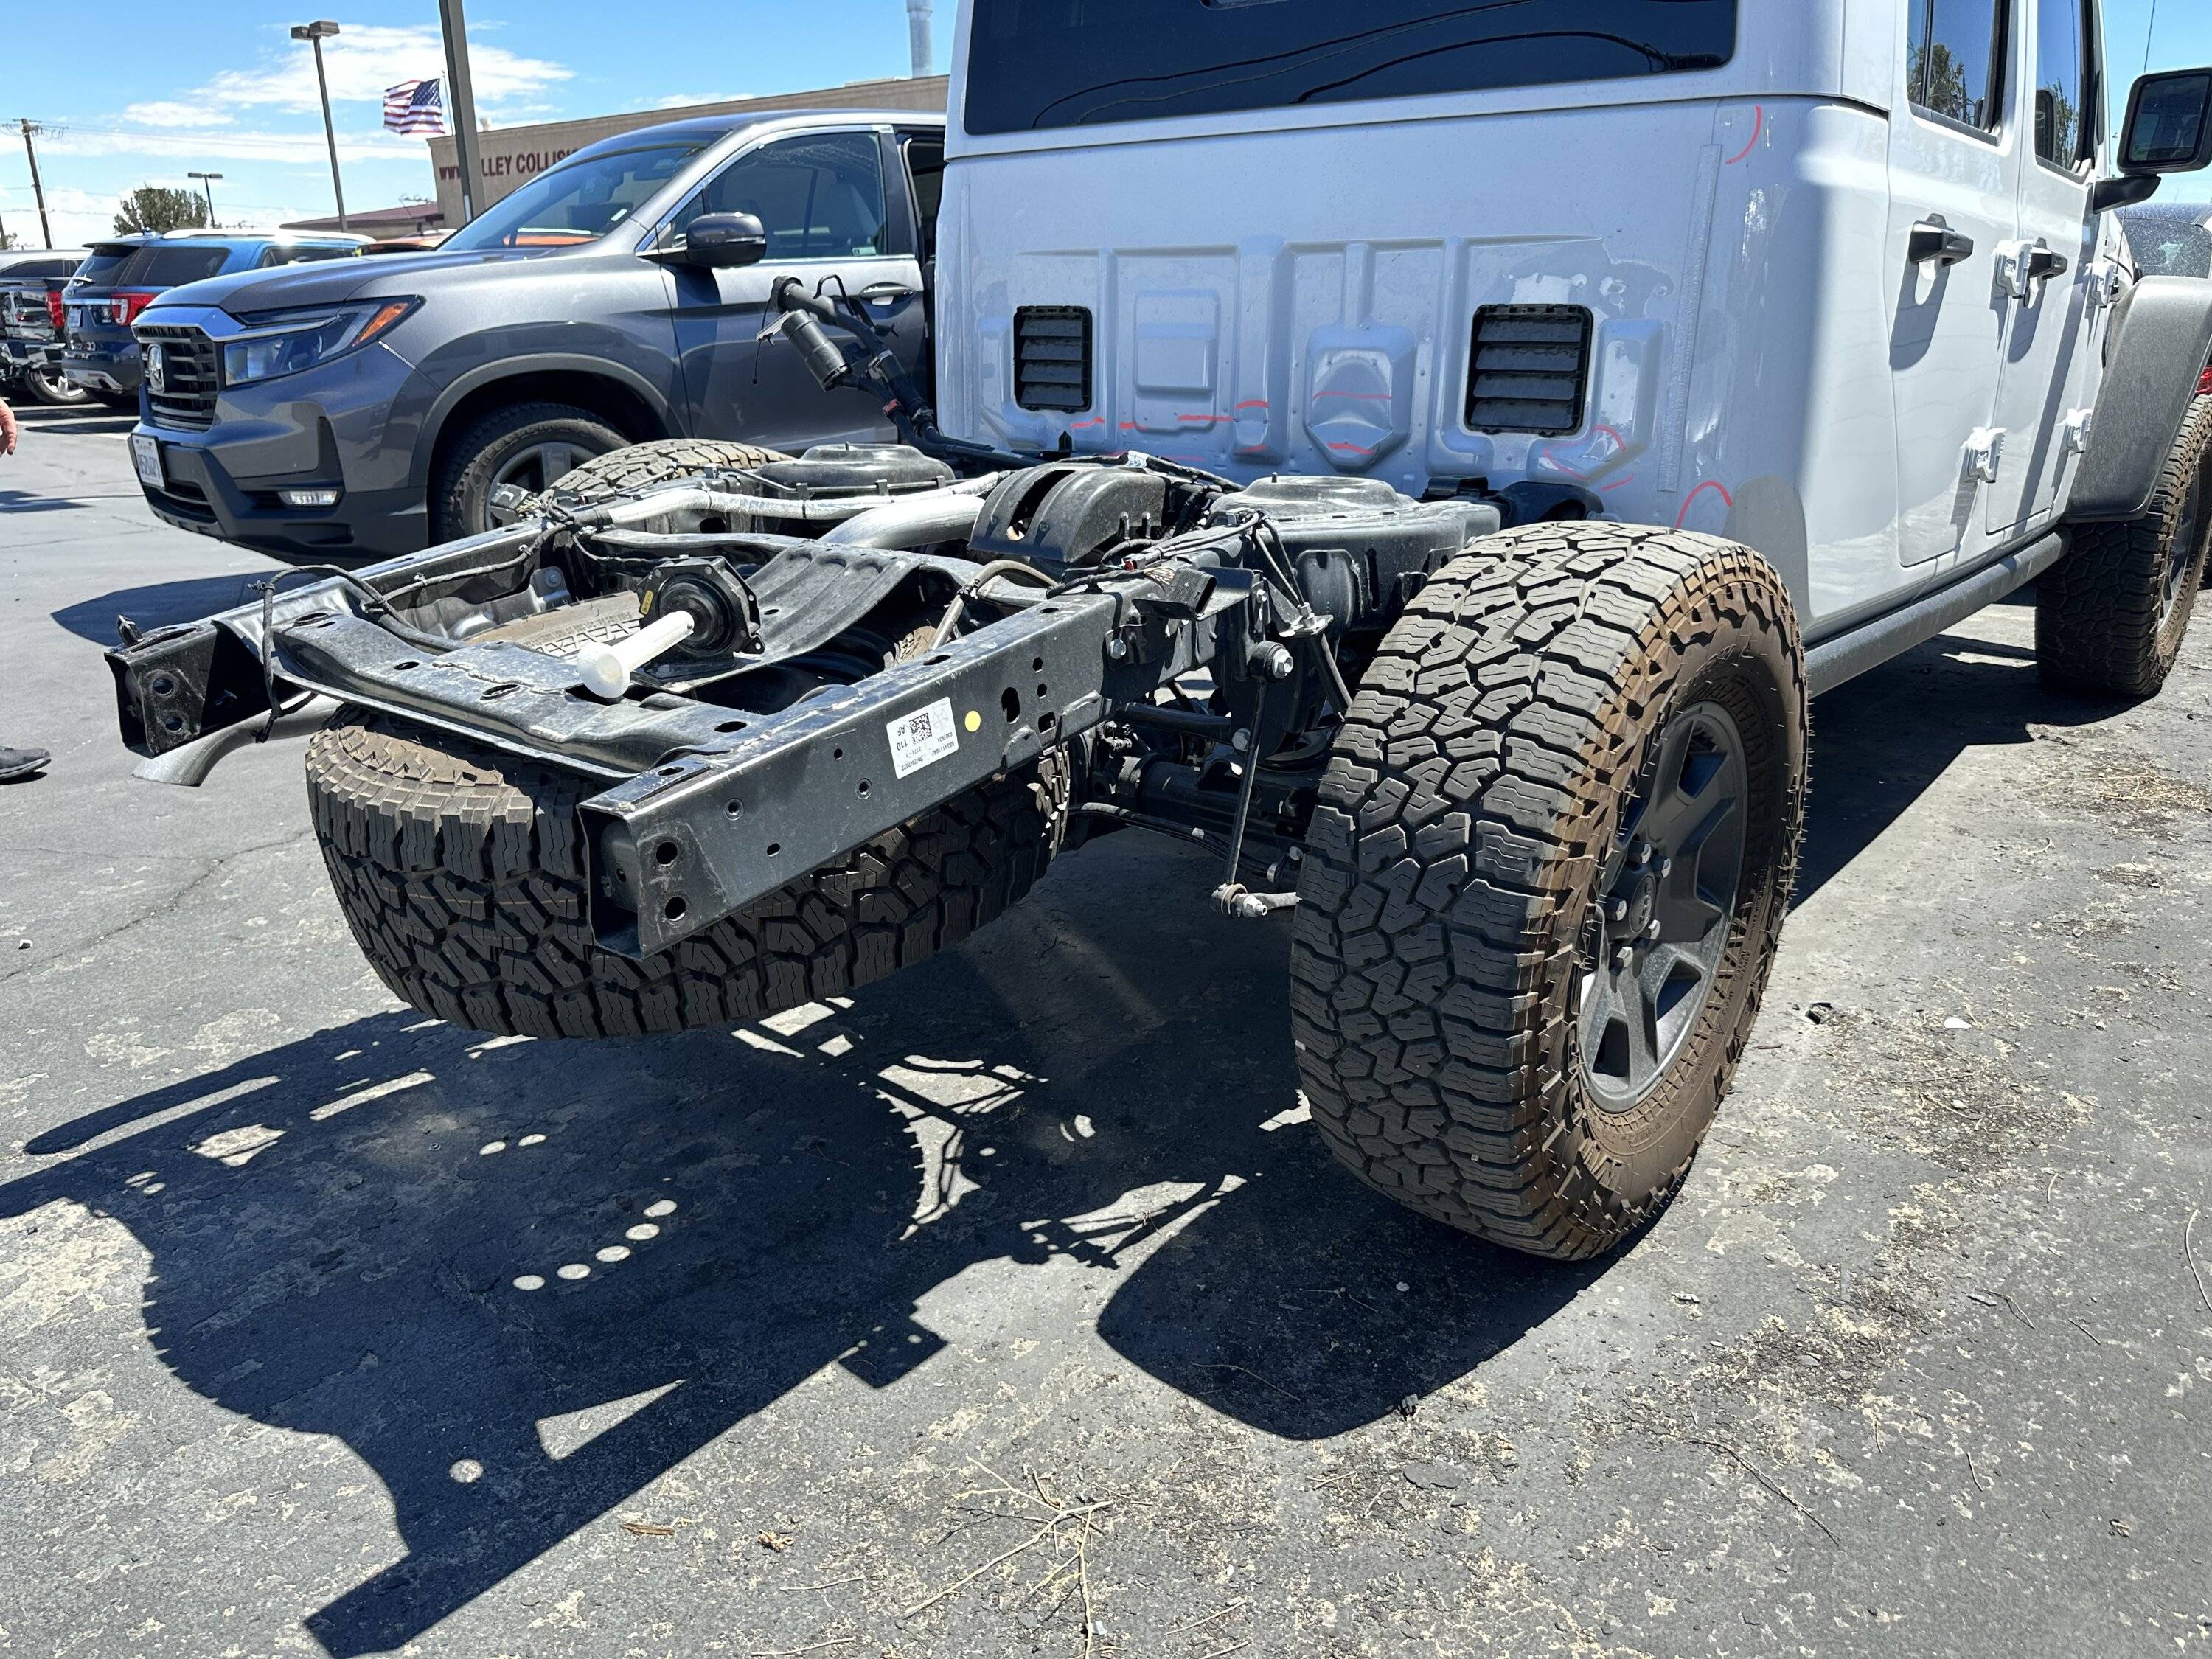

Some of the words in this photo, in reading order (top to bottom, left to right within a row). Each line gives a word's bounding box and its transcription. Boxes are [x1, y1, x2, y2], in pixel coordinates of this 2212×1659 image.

[516, 147, 579, 173] COLLIS
[897, 725, 905, 737] AF
[897, 740, 908, 751] 110
